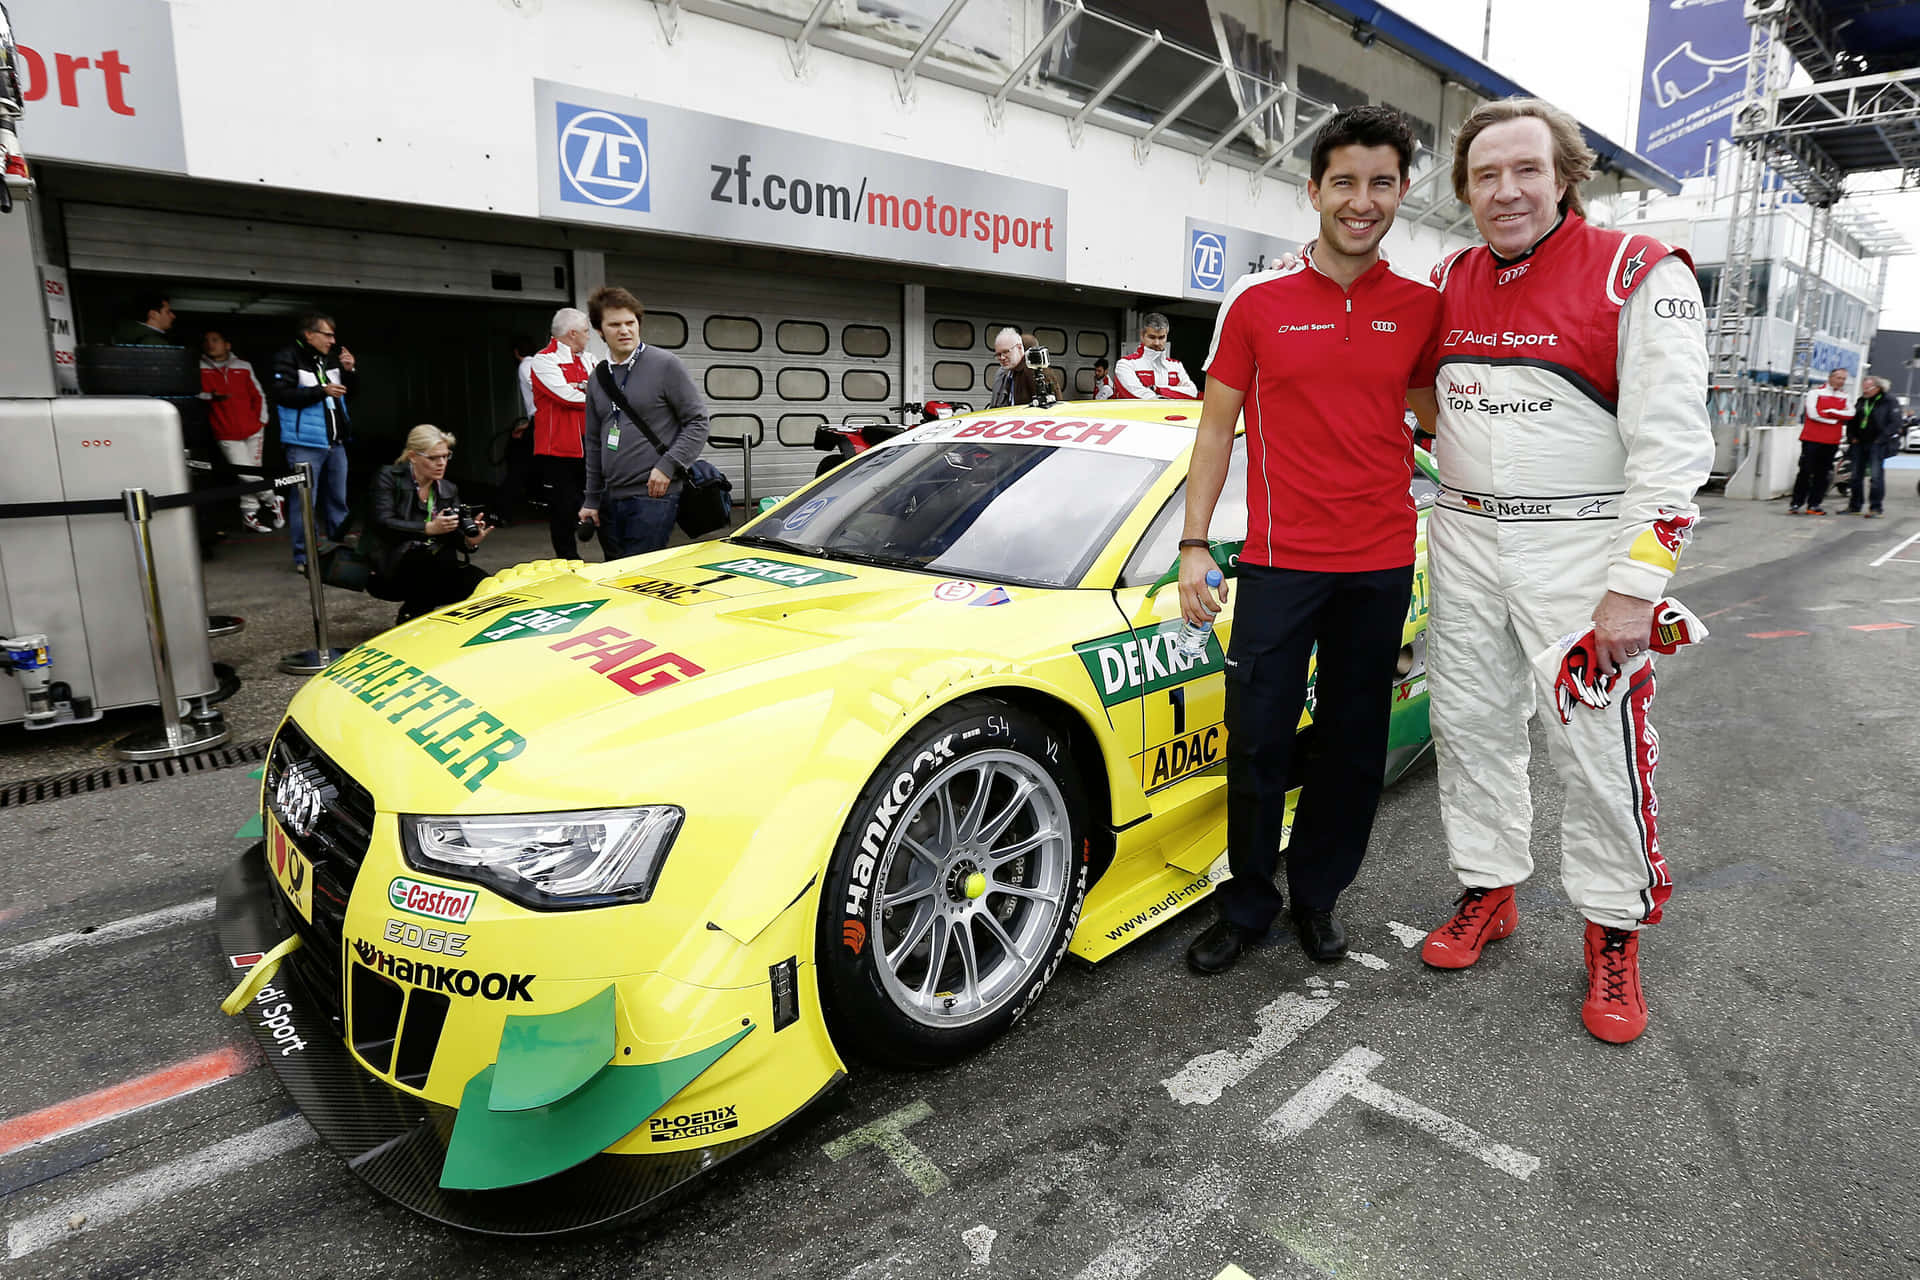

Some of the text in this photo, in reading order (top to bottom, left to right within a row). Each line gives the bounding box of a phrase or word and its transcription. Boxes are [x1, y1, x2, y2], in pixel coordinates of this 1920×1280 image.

[562, 126, 643, 190] ZF
[710, 154, 1054, 253] zf.com/motorsport
[1195, 243, 1223, 279] ZF
[1289, 323, 1336, 332] Audi Sport
[1462, 331, 1559, 348] Audi Sport
[1448, 382, 1482, 396] Audi
[1448, 397, 1554, 415] Top Service
[952, 420, 1128, 445] BOSCH
[1497, 501, 1552, 516] Netzer
[717, 558, 824, 585] DEKRA
[623, 580, 701, 600] ADAC
[547, 625, 706, 697] FAG
[322, 645, 527, 793] CHAEFFLER
[1168, 686, 1185, 736] 1
[1150, 726, 1219, 787] ADAC
[407, 885, 470, 919] Castrol
[383, 918, 472, 958] EDGE
[259, 1002, 308, 1057] Sport
